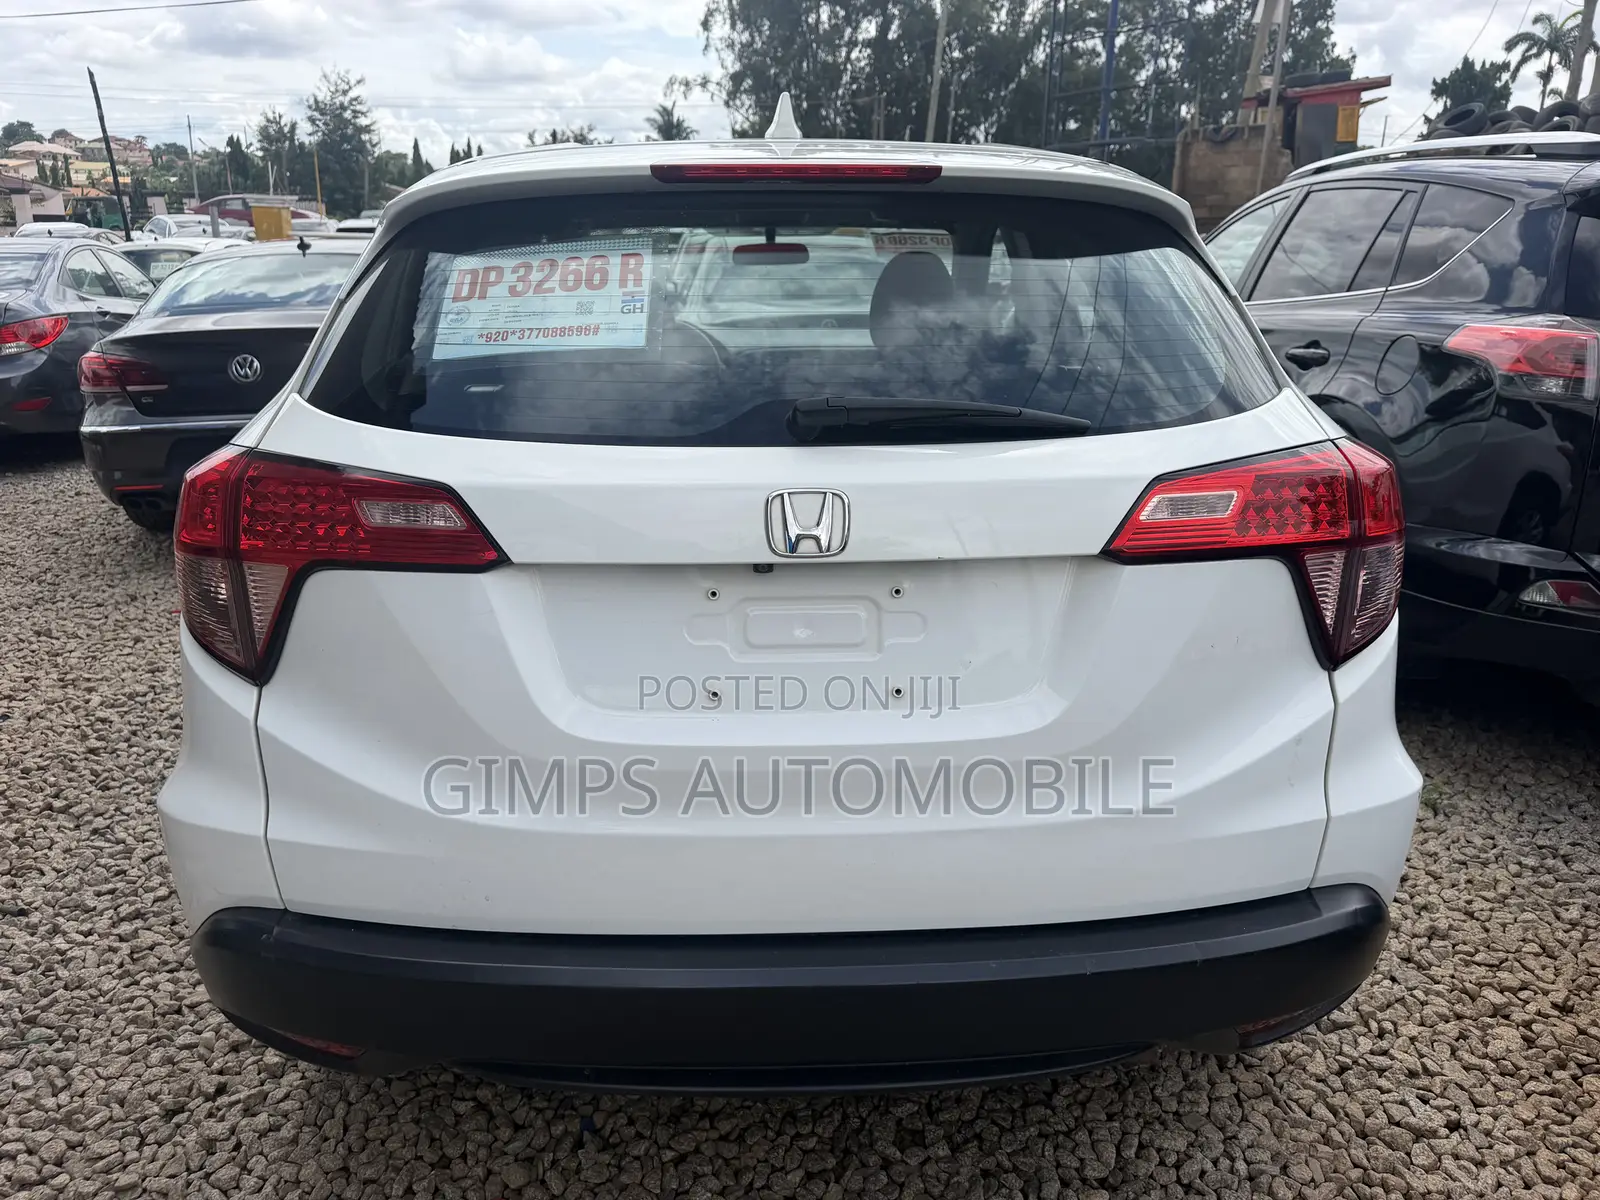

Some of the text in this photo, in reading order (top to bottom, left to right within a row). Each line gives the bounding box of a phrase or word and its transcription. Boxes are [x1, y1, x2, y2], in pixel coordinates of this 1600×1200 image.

[452, 253, 644, 303] DP 3266 R
[620, 303, 645, 315] GH
